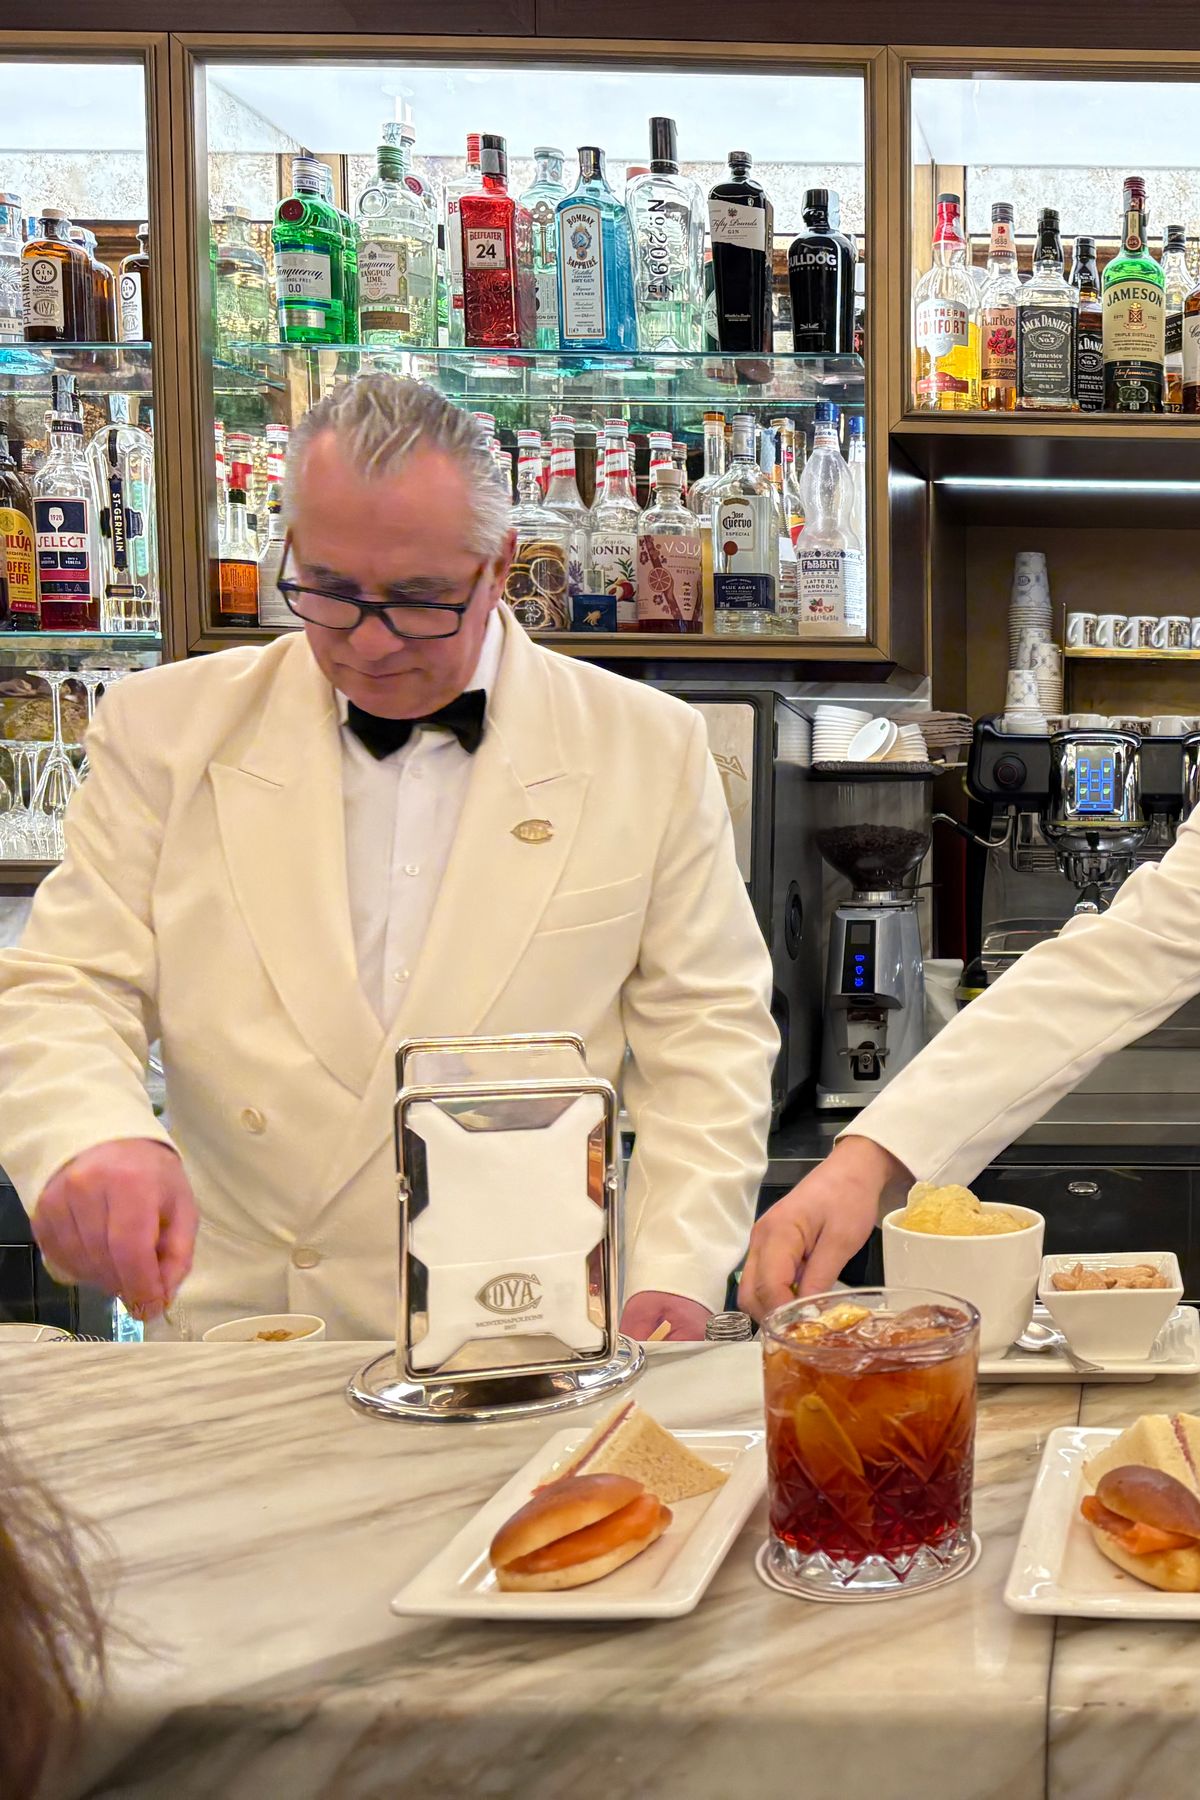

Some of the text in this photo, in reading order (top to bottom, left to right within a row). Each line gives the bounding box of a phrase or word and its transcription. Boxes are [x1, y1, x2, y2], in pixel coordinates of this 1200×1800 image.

[567, 213, 596, 227] BOMBAY
[729, 218, 758, 227] Pounds
[469, 231, 502, 241] BEEFEATER
[476, 244, 497, 259] 24
[566, 255, 598, 270] SAPPHIRE
[21, 262, 31, 325] PHARMACY
[288, 283, 302, 293] 0.0
[648, 285, 675, 293] GIN
[1107, 288, 1163, 307] JAMESON
[1000, 315, 1016, 327] Ros
[1022, 315, 1073, 335] JACK DANIEL'S
[732, 511, 744, 519] Jose
[112, 493, 125, 552] ST-GERMAIN
[722, 516, 752, 530] Cuervo
[38, 535, 87, 548] SELECT
[7, 561, 31, 573] OFFEE
[803, 560, 838, 569] FABBRI
[9, 573, 30, 585] EUR
